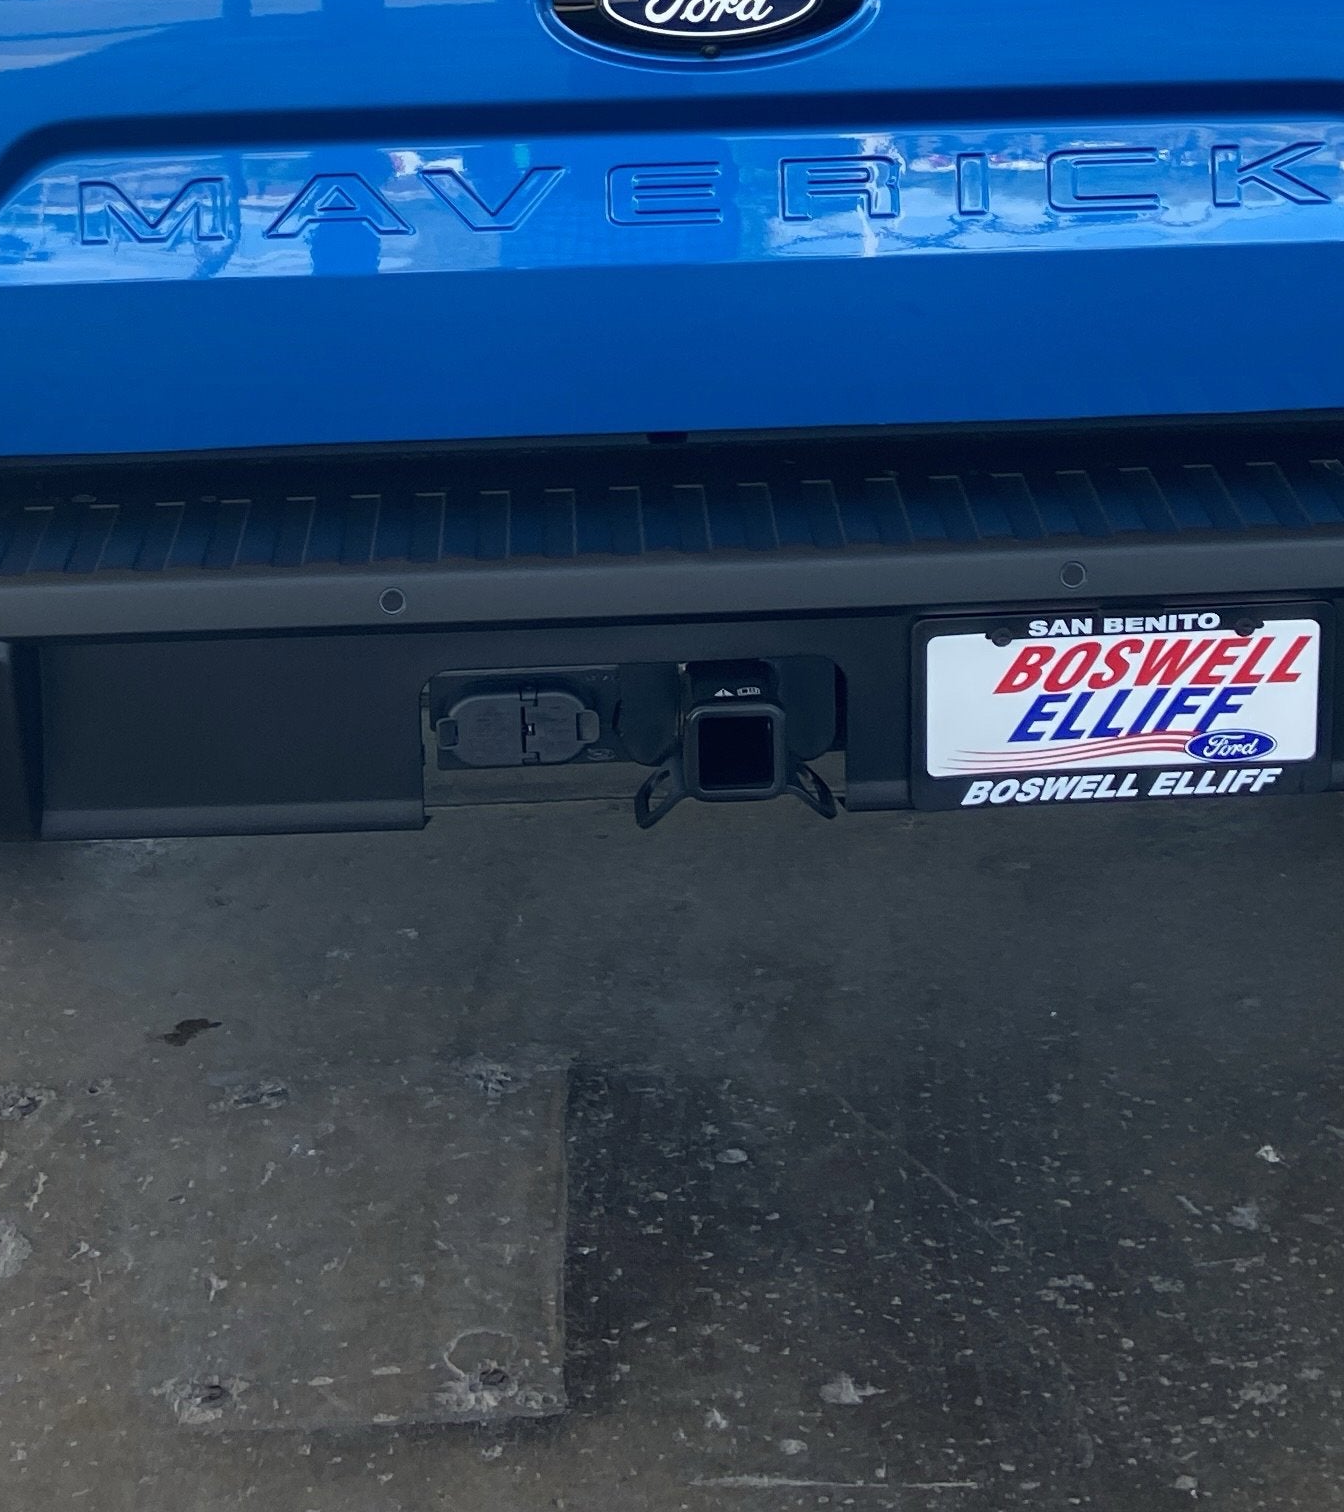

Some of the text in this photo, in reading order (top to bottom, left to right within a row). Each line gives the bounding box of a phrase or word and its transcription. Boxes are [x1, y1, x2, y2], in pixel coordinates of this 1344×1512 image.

[76, 141, 1329, 246] MAVERICK
[1028, 613, 1220, 637] SAN BENITO
[993, 636, 1312, 694] BOSWELL
[1008, 686, 1257, 742] ELLIFF
[1202, 734, 1258, 757] Ford
[961, 767, 1283, 806] BOSWELL ELLIFF
